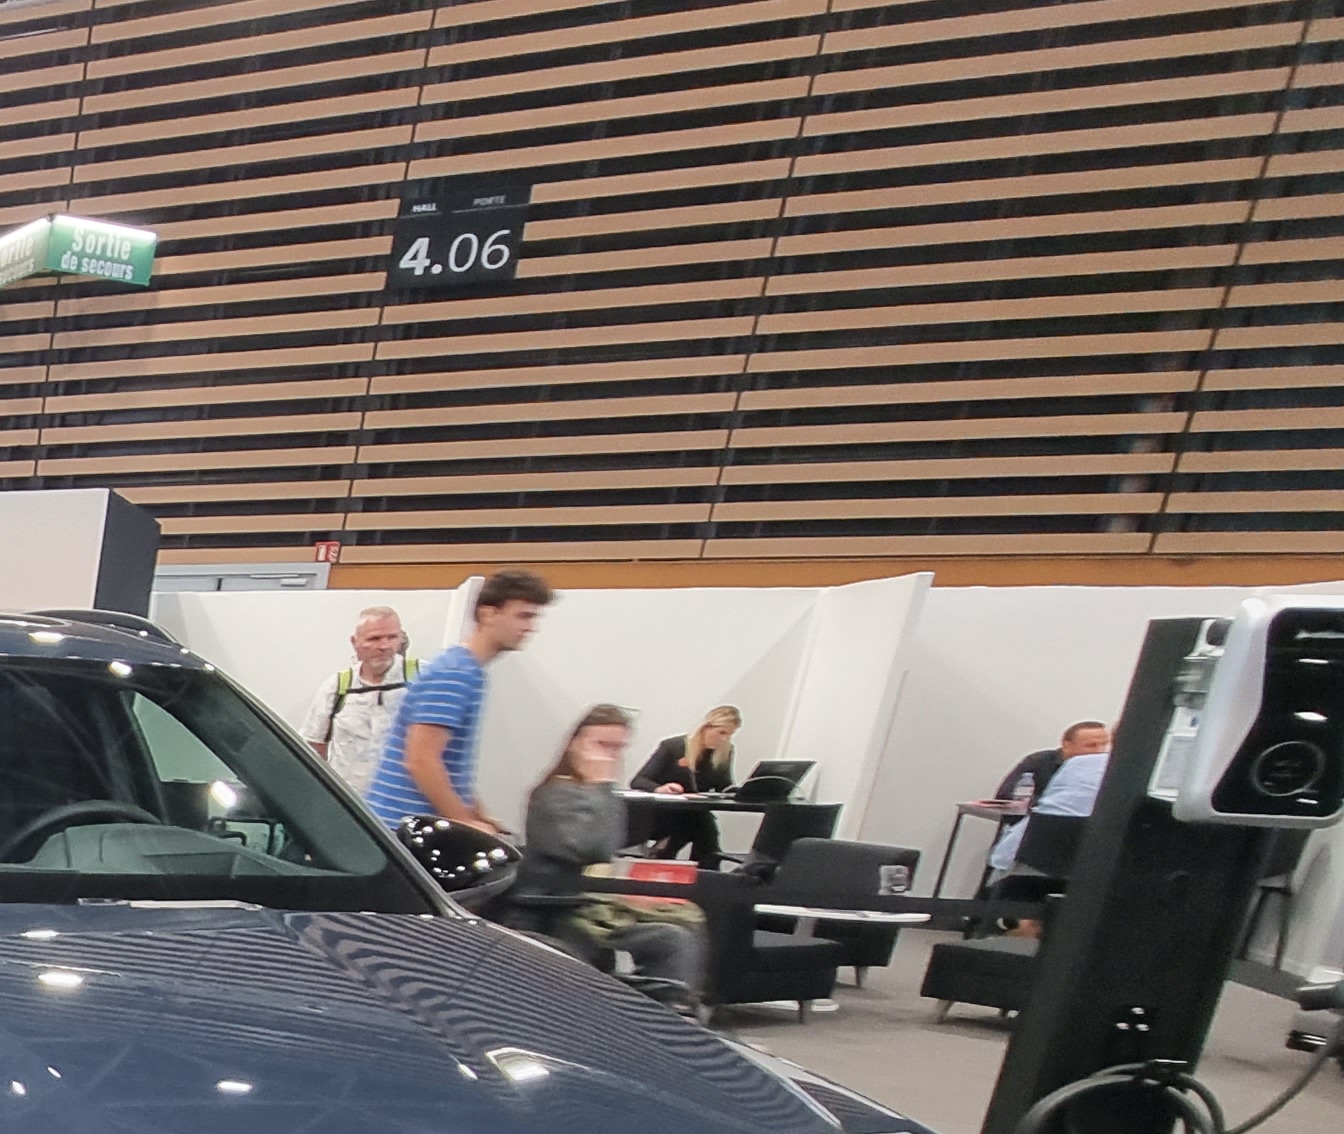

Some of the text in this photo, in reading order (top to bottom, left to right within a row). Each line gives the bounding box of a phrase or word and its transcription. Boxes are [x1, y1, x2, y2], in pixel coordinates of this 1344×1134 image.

[71, 227, 133, 260] Sortie
[398, 229, 511, 276] 4.06
[60, 251, 134, 280] de secours
